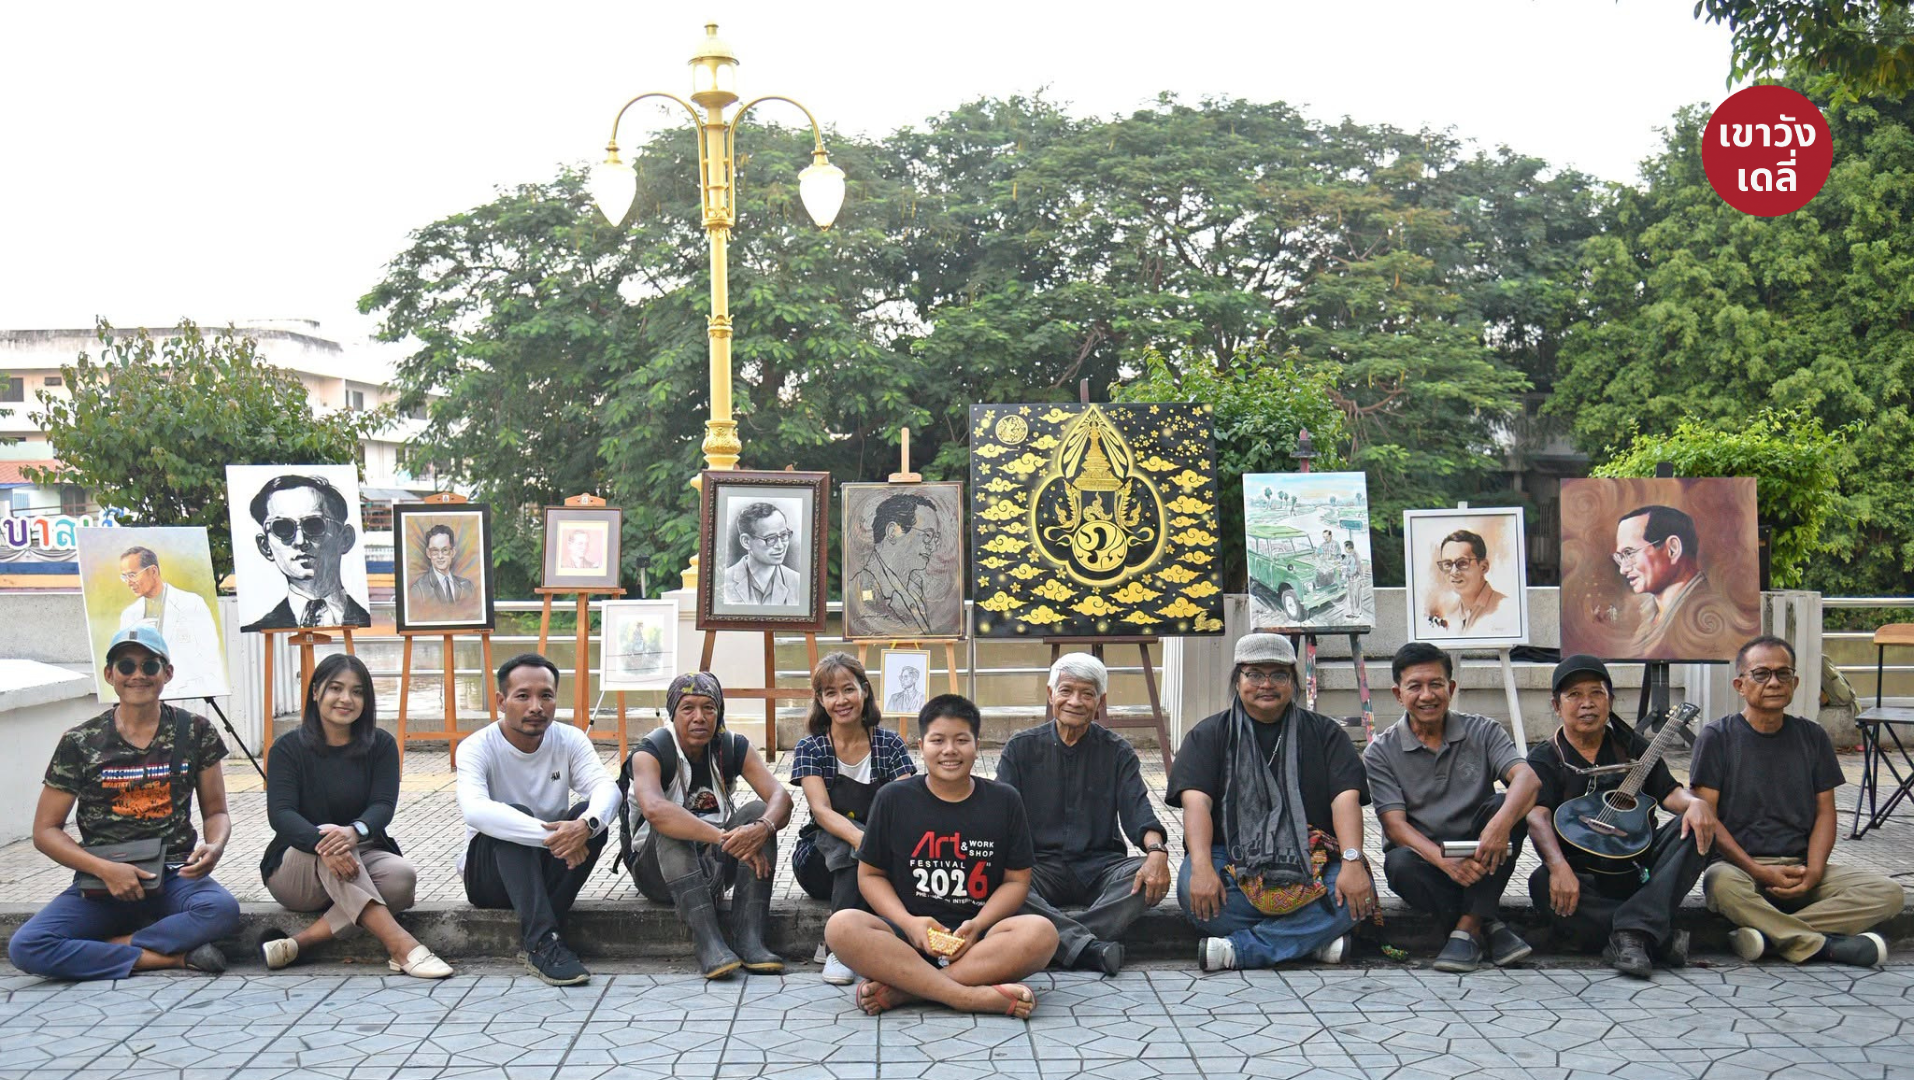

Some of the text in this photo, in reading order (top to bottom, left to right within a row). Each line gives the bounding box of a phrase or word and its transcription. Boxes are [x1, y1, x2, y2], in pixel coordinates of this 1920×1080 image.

[911, 831, 966, 859] Art
[969, 840, 995, 848] WORK
[969, 849, 994, 858] SHOP
[910, 859, 966, 869] FESTIVAL
